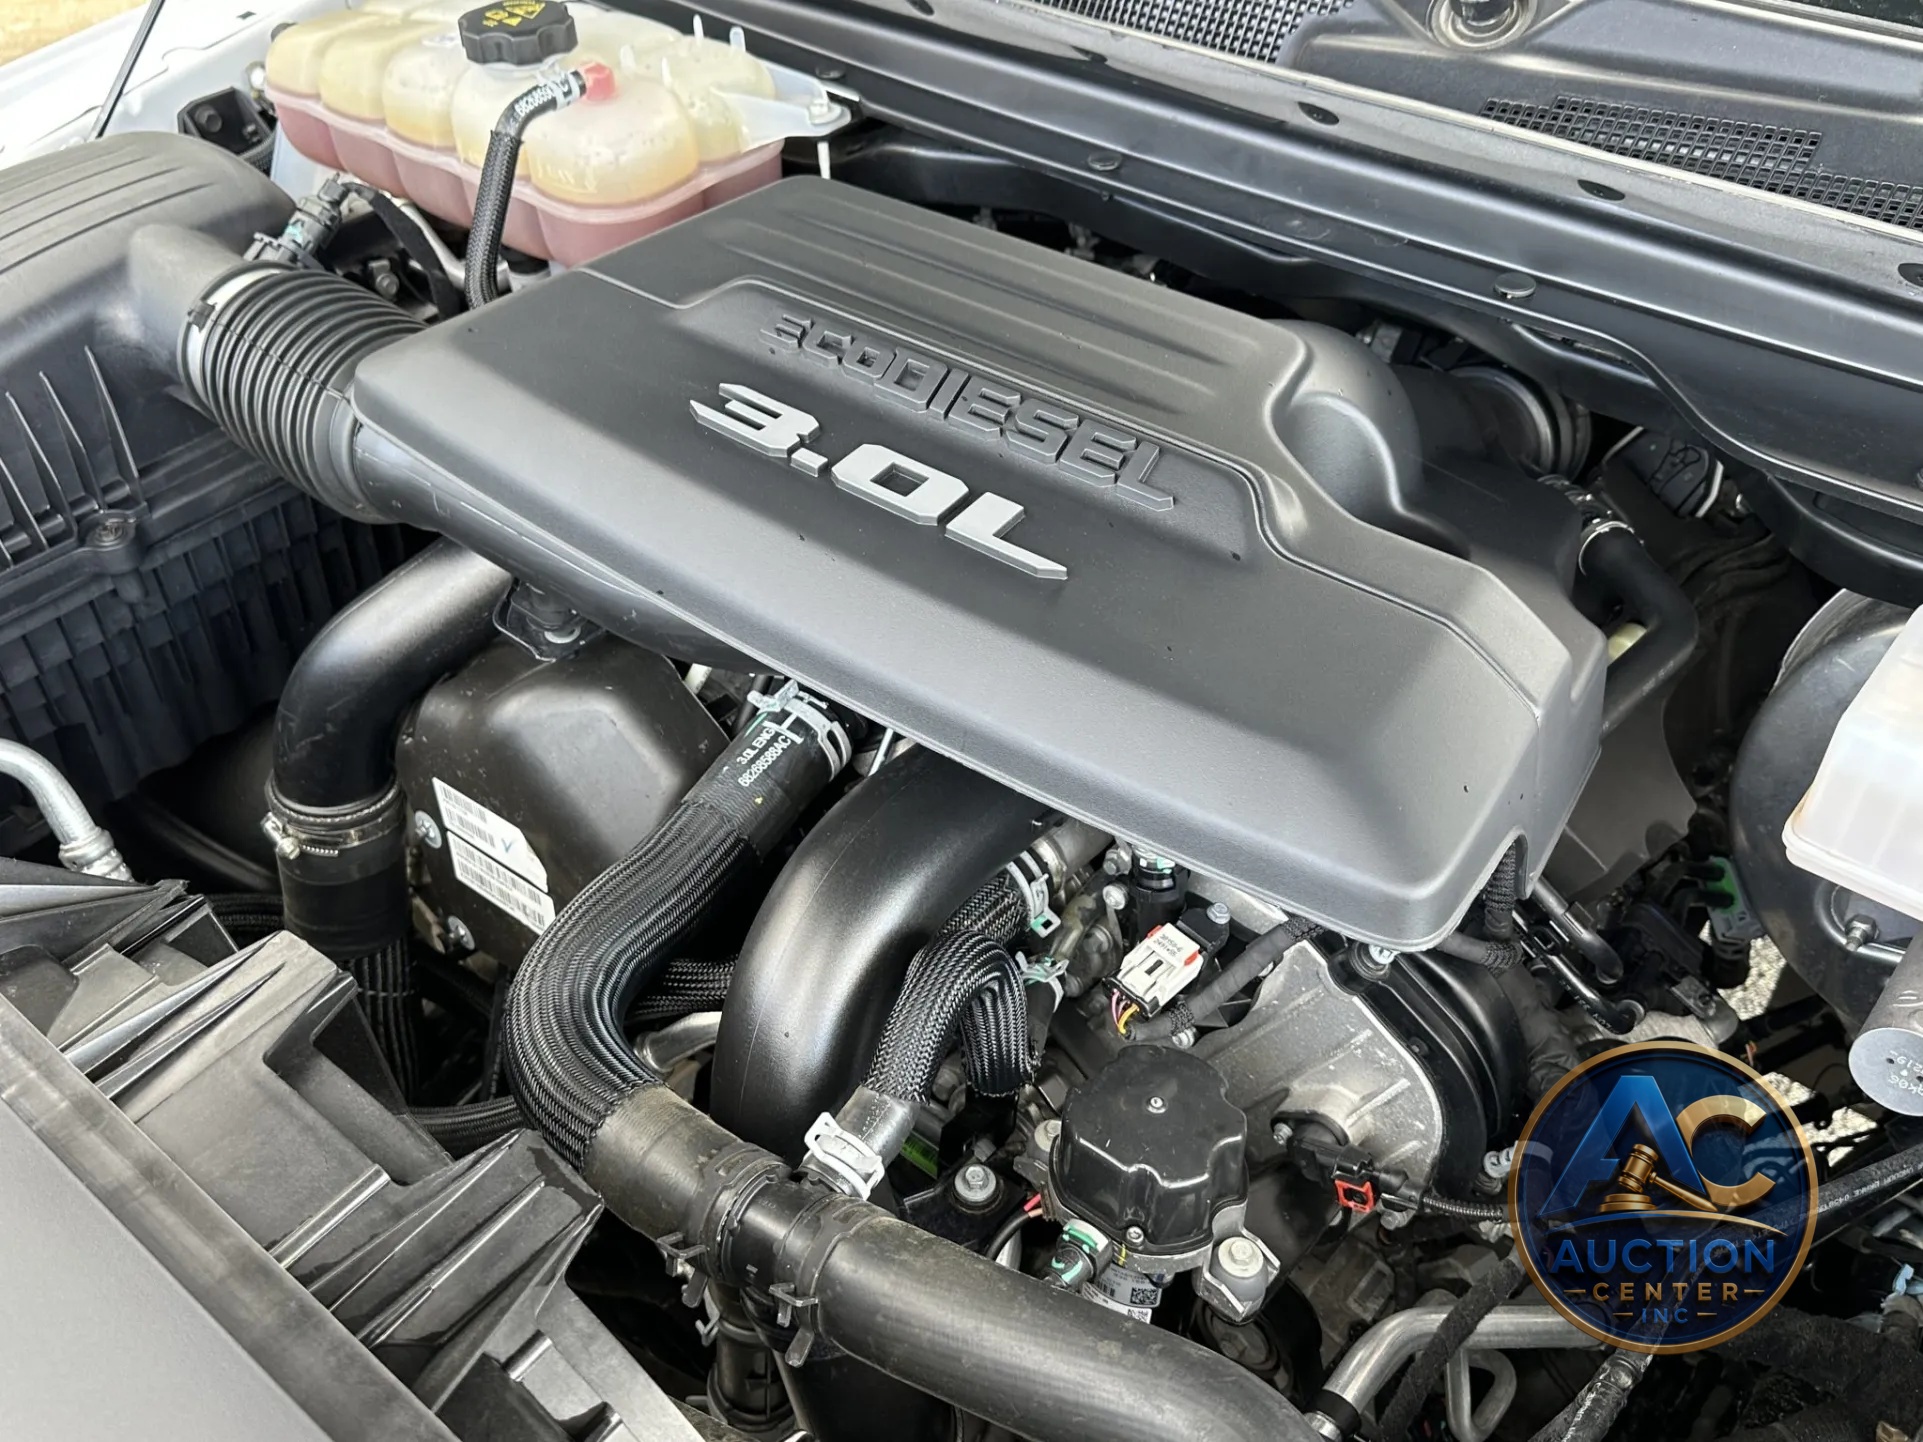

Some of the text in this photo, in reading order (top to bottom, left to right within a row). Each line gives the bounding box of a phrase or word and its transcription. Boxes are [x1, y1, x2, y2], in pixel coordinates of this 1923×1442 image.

[759, 314, 1174, 512] ECODIESEL
[690, 382, 1068, 580] 3.0L
[736, 727, 775, 765] 3.0L ENG
[738, 735, 792, 787] 68268588AC
